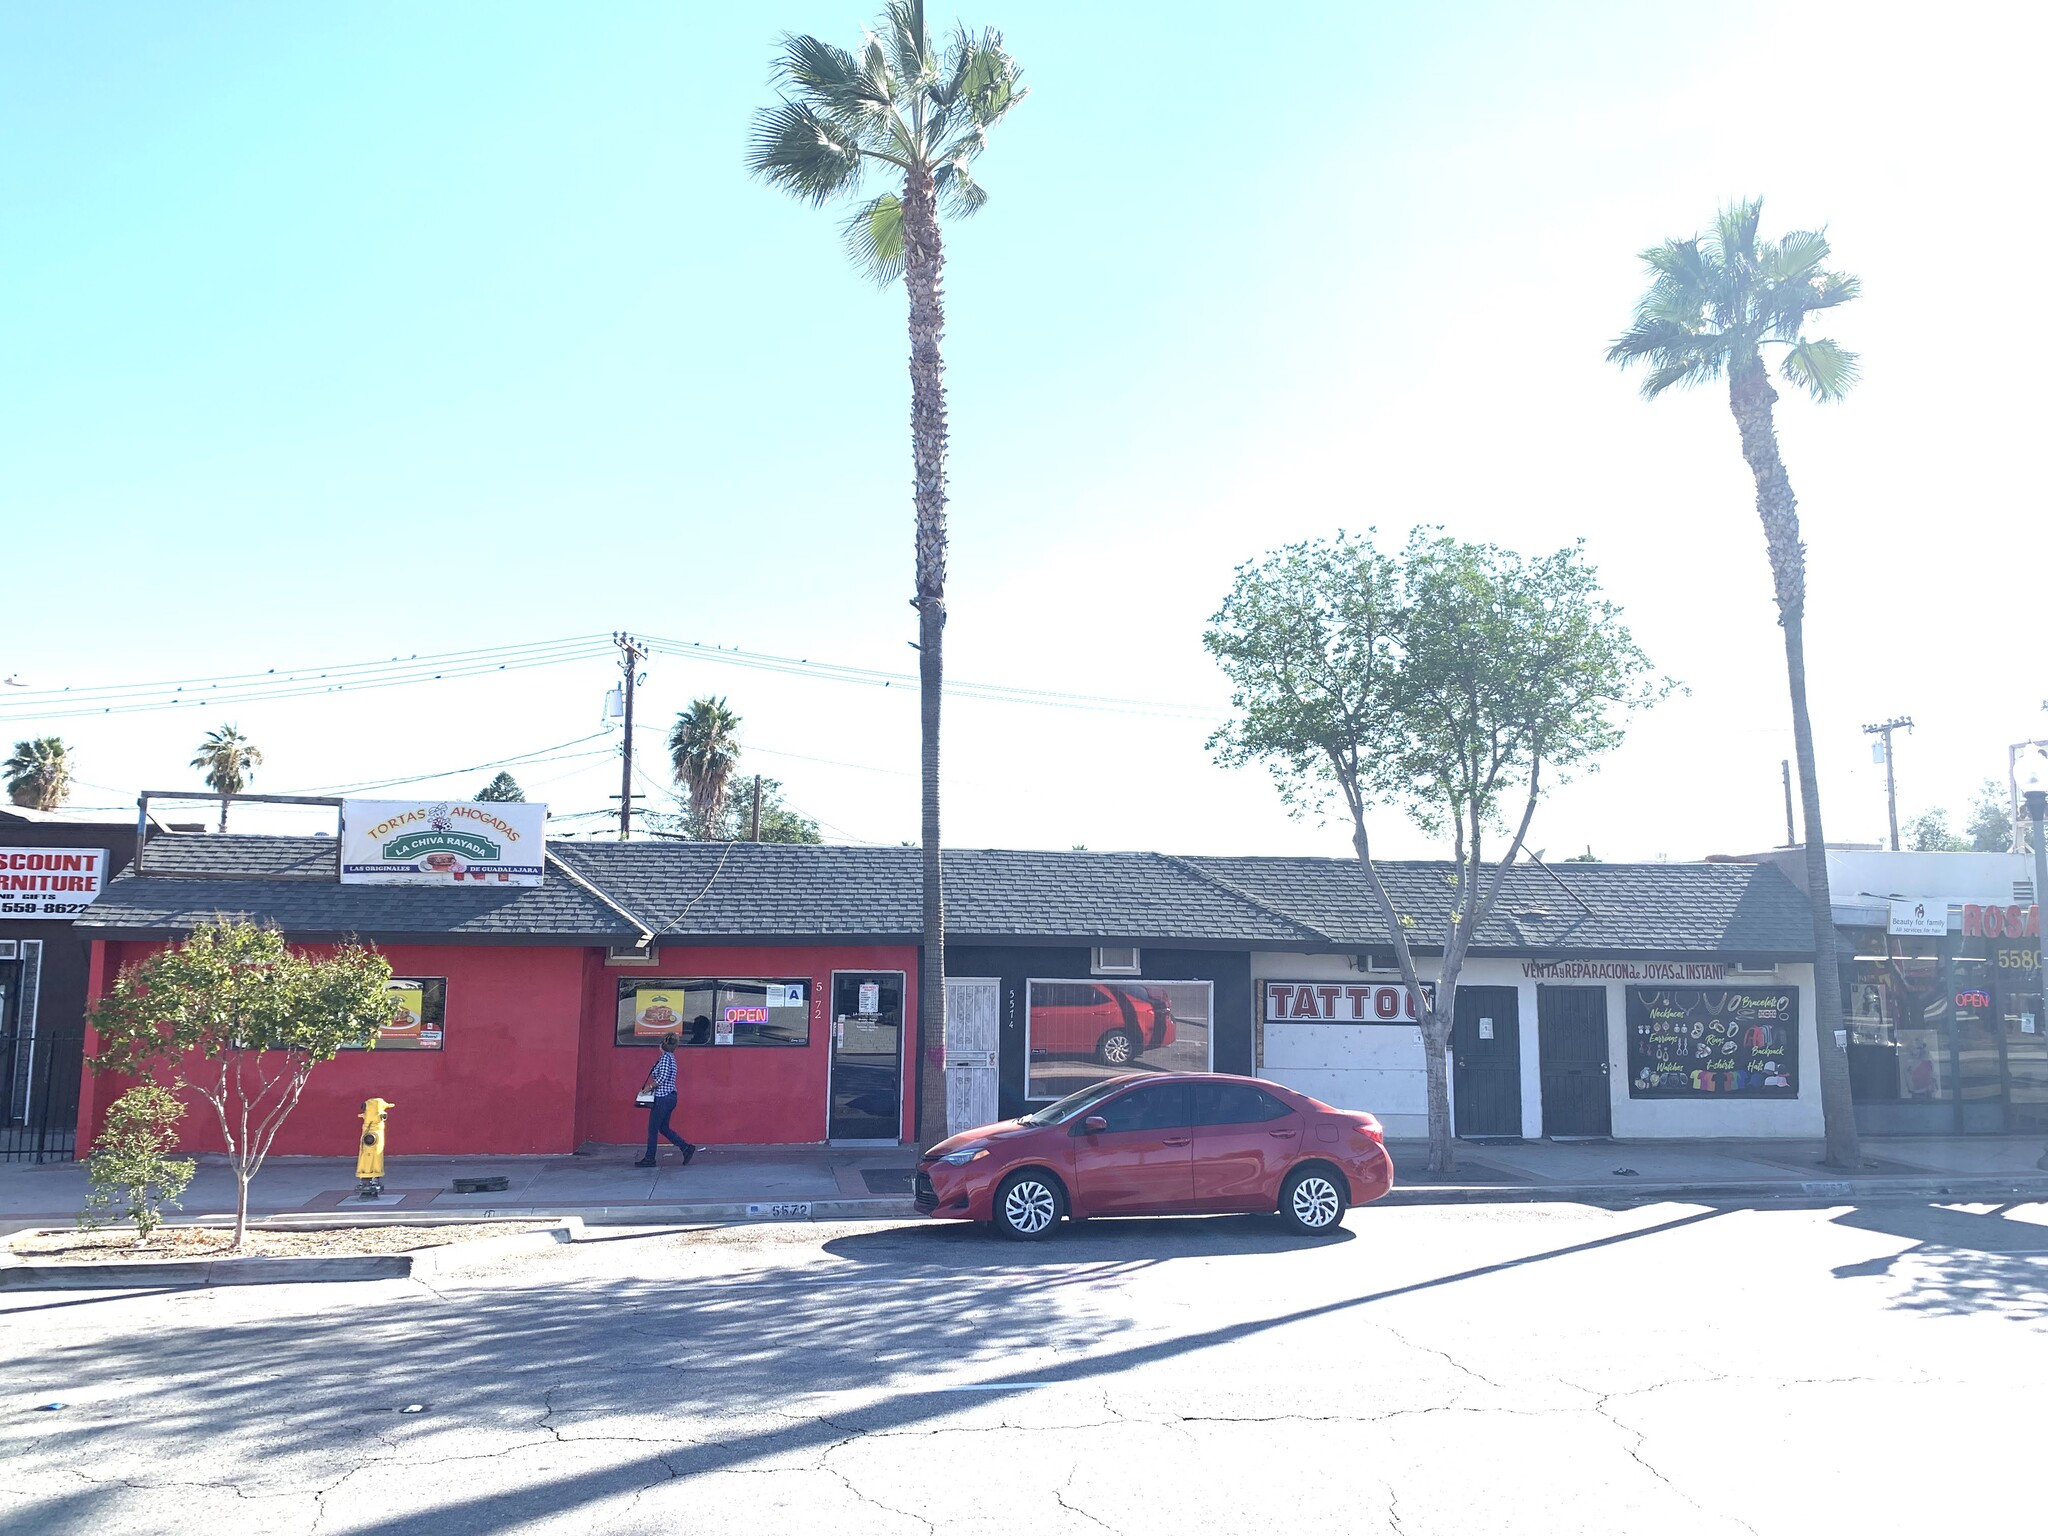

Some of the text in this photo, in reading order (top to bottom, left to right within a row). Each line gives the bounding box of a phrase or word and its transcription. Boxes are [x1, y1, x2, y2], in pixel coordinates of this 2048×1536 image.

[367, 806, 520, 843] TORTAS AHOGADAS
[395, 836, 486, 857] LA CHIVA RAYADA
[481, 866, 539, 874] GUADALAJARA
[1892, 917, 1946, 928] Beauty for family
[1564, 963, 1630, 980] REPARACION
[1642, 963, 1676, 980] JOYAS
[789, 989, 800, 1000] A
[1955, 993, 1989, 1008] OPEN
[726, 1008, 767, 1023] OPEN
[1649, 1007, 1685, 1019] Necklaces
[1649, 1032, 1679, 1045] Earrings
[1705, 1033, 1725, 1046] Rings
[1751, 1045, 1785, 1057] Backpack
[1656, 1062, 1684, 1072] Watches
[1747, 1059, 1764, 1072] Hats
[772, 1204, 808, 1217] 5572
